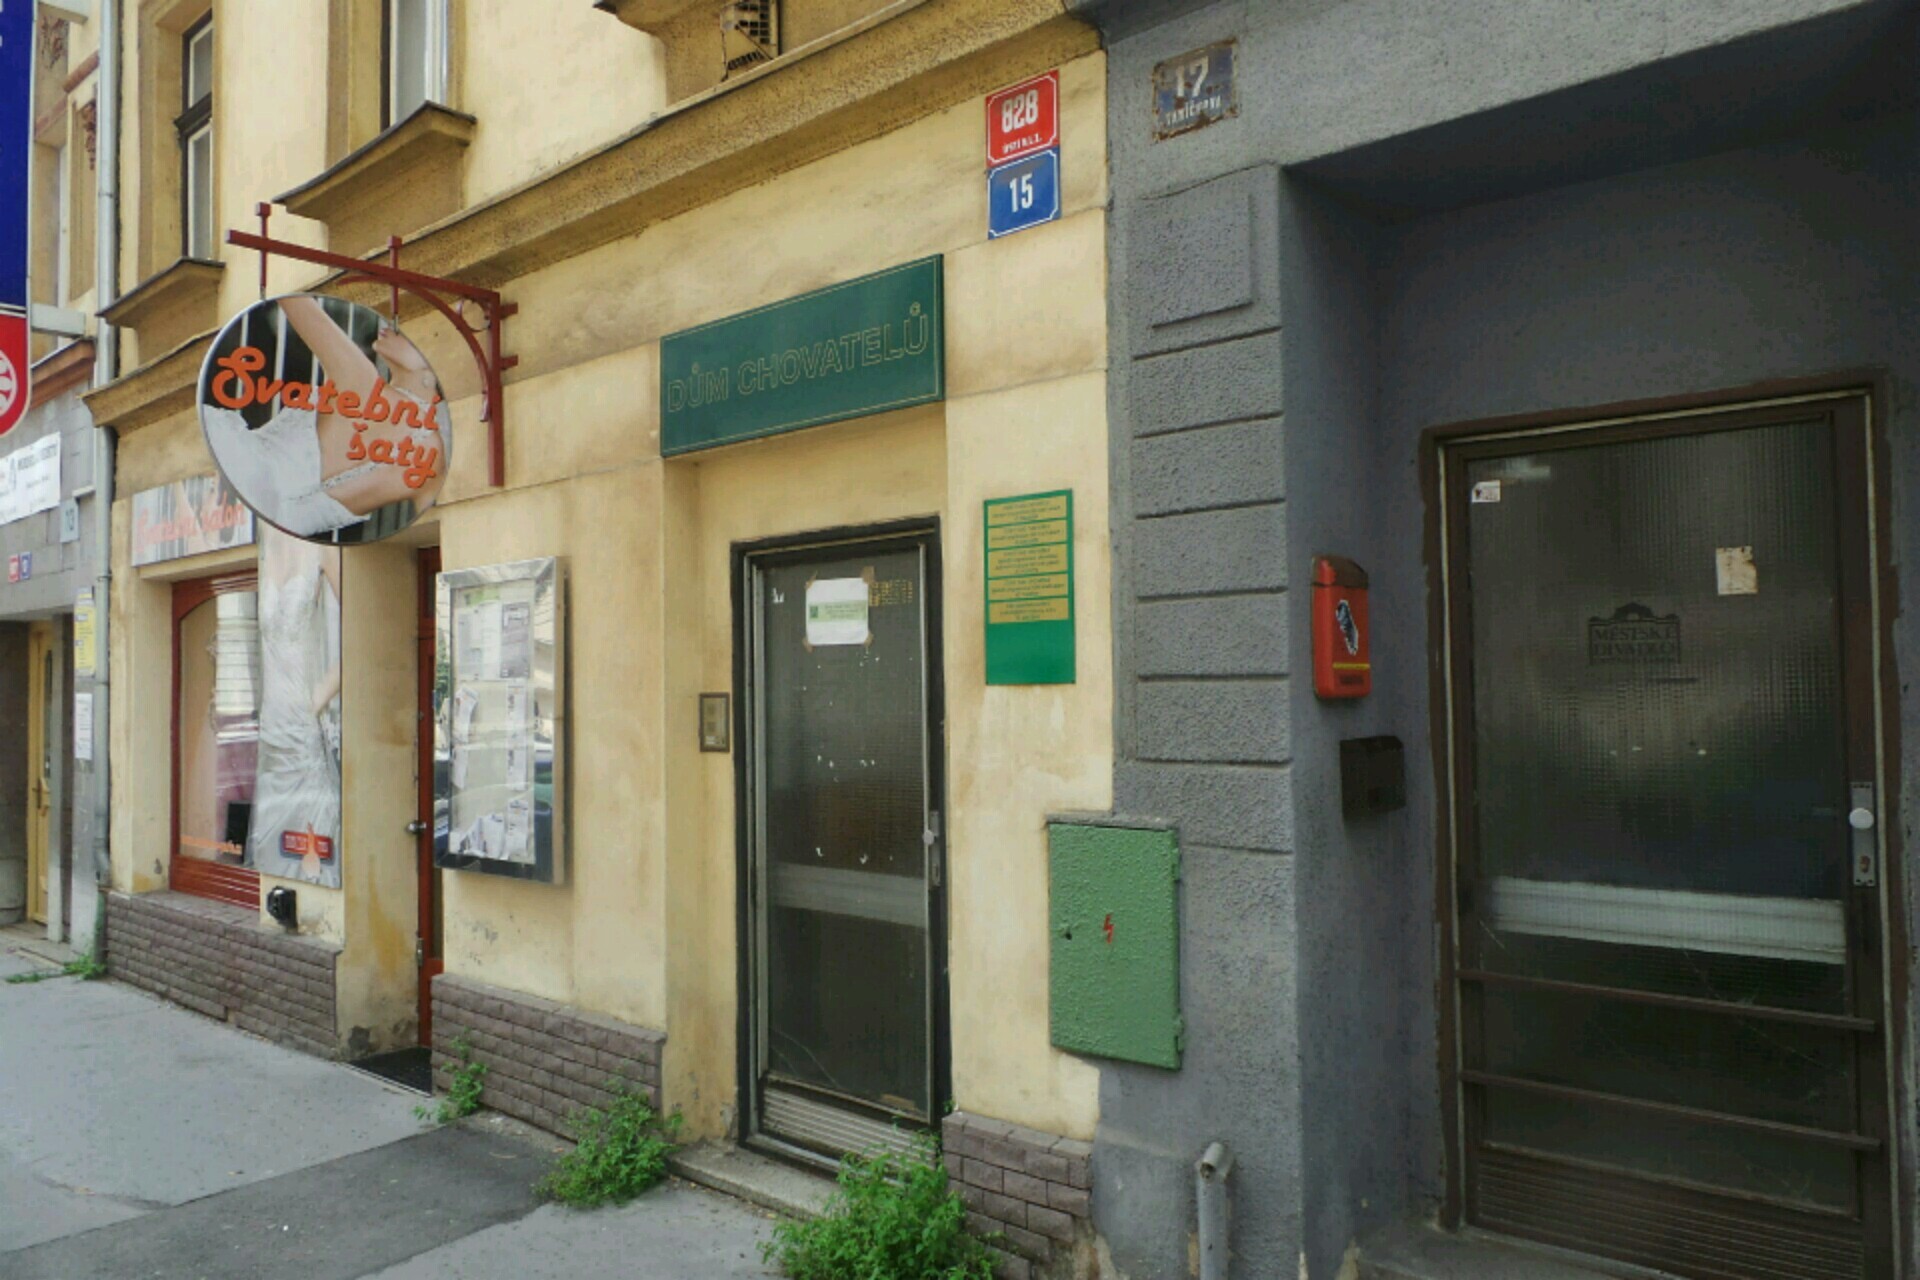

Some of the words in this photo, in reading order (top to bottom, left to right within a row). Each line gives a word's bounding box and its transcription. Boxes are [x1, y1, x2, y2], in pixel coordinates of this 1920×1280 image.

[1175, 55, 1209, 98] 17
[1001, 89, 1039, 134] 828
[1009, 173, 1033, 213] 15
[667, 362, 729, 413] DŮM
[737, 301, 929, 396] CHOVATELŮ
[211, 345, 442, 432] Svatební
[346, 421, 438, 489] šaty
